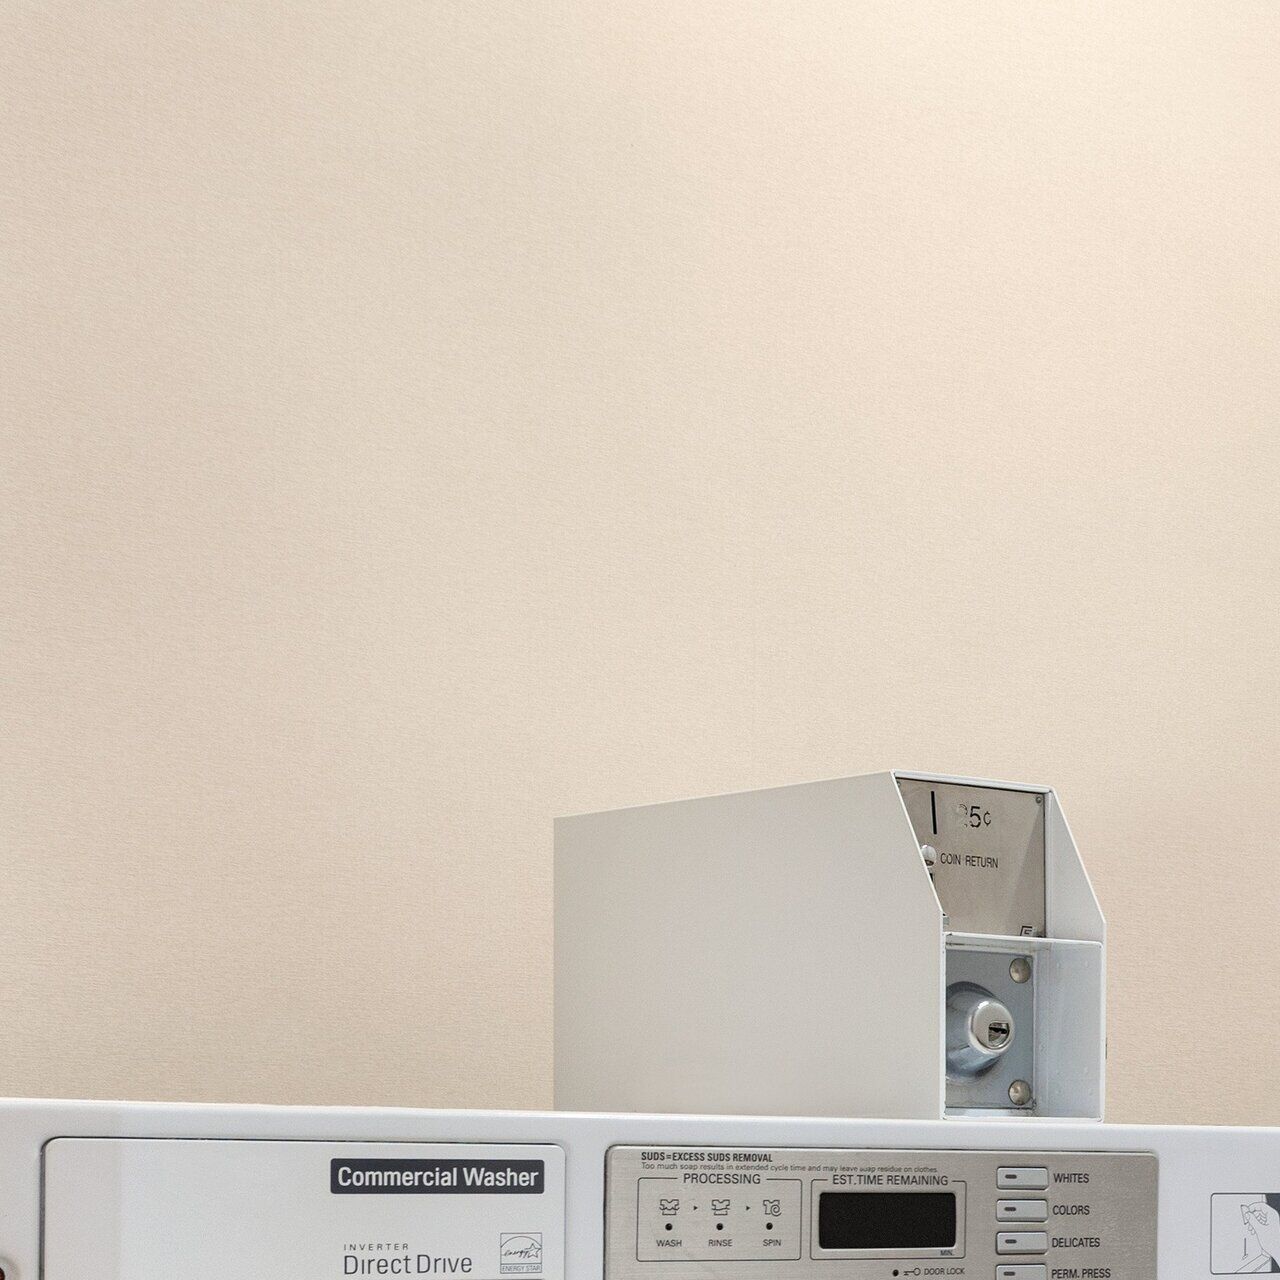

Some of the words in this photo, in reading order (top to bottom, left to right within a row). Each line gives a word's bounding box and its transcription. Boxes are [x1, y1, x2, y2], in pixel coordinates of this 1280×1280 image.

[940, 853, 961, 866] COIN
[965, 855, 999, 868] RETURN
[707, 1152, 730, 1162] SUDS
[732, 1153, 773, 1162] REMOVAL
[338, 1166, 457, 1186] Commercial
[463, 1167, 539, 1186] Washer
[683, 1173, 761, 1184] PROCESSING
[886, 1175, 949, 1186] REMAINING
[1053, 1173, 1090, 1184] WHITES
[1052, 1205, 1090, 1216] COLORS
[1052, 1237, 1100, 1248] DELICATES
[344, 1255, 412, 1275] Direct
[417, 1254, 472, 1274] Drive
[1051, 1269, 1079, 1279] PERM.
[1082, 1268, 1111, 1278] PRESS
